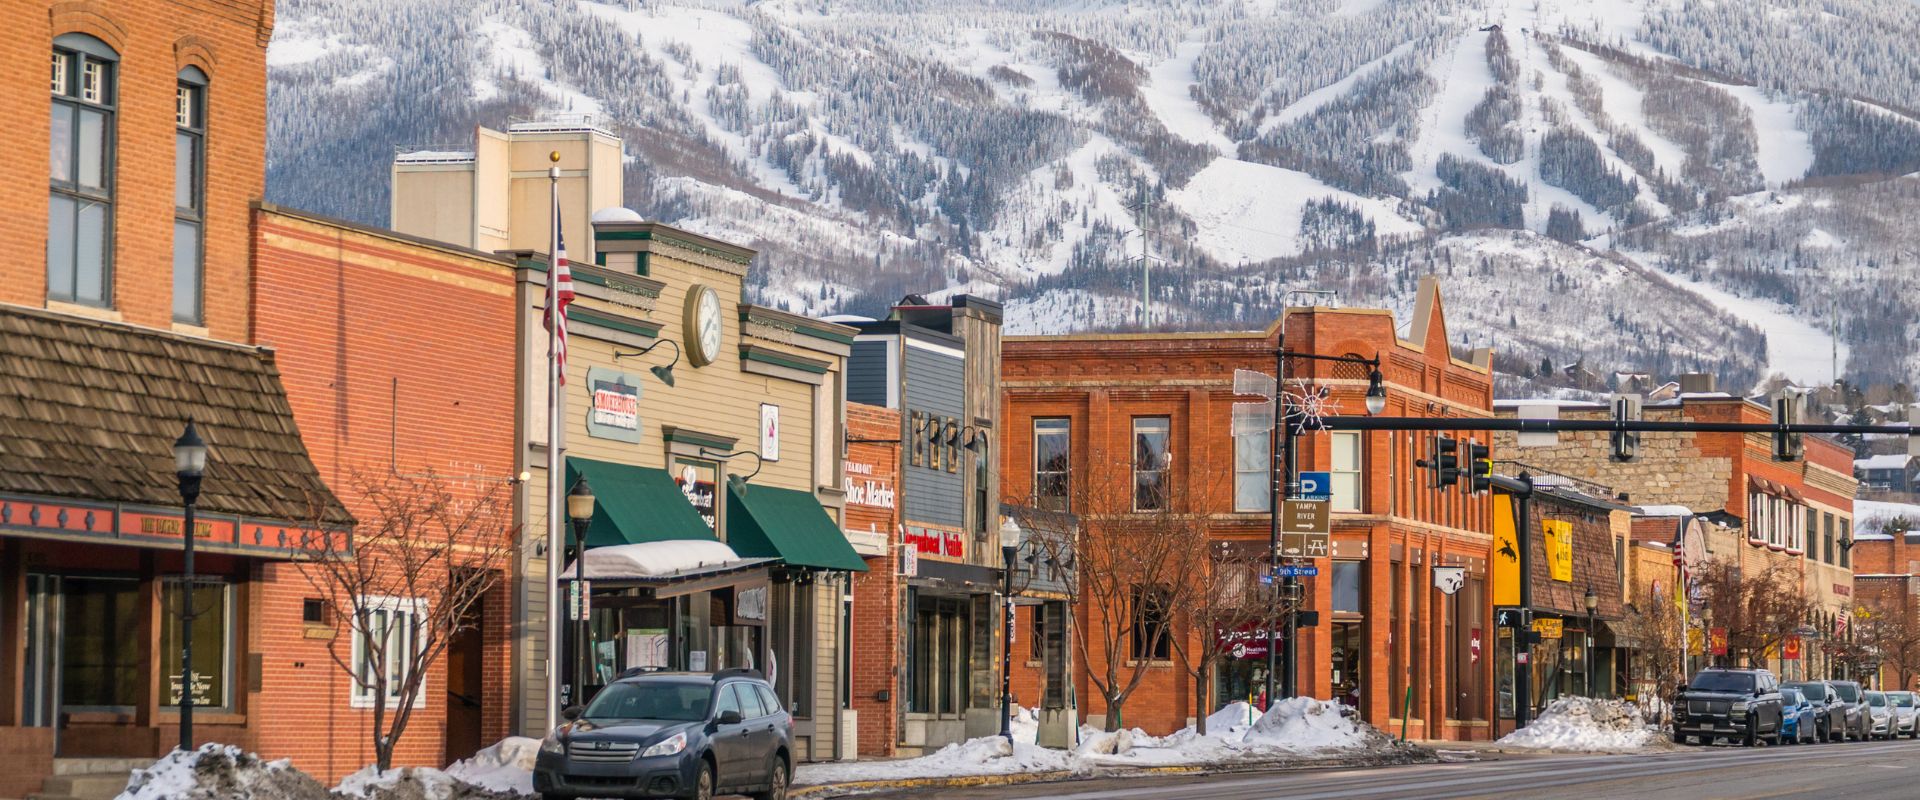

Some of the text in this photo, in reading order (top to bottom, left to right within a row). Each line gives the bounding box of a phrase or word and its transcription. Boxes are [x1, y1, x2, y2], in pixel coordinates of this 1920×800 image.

[596, 391, 637, 416] SMOKEHOUSE
[845, 461, 873, 475] TEAMBOAT
[845, 476, 895, 509] Shoe Market
[1295, 502, 1317, 511] YAMPA
[1296, 512, 1316, 521] RIVER
[905, 527, 963, 557] teamboat Nails
[1279, 568, 1316, 576] 9th Street
[1254, 628, 1282, 641] Dru
